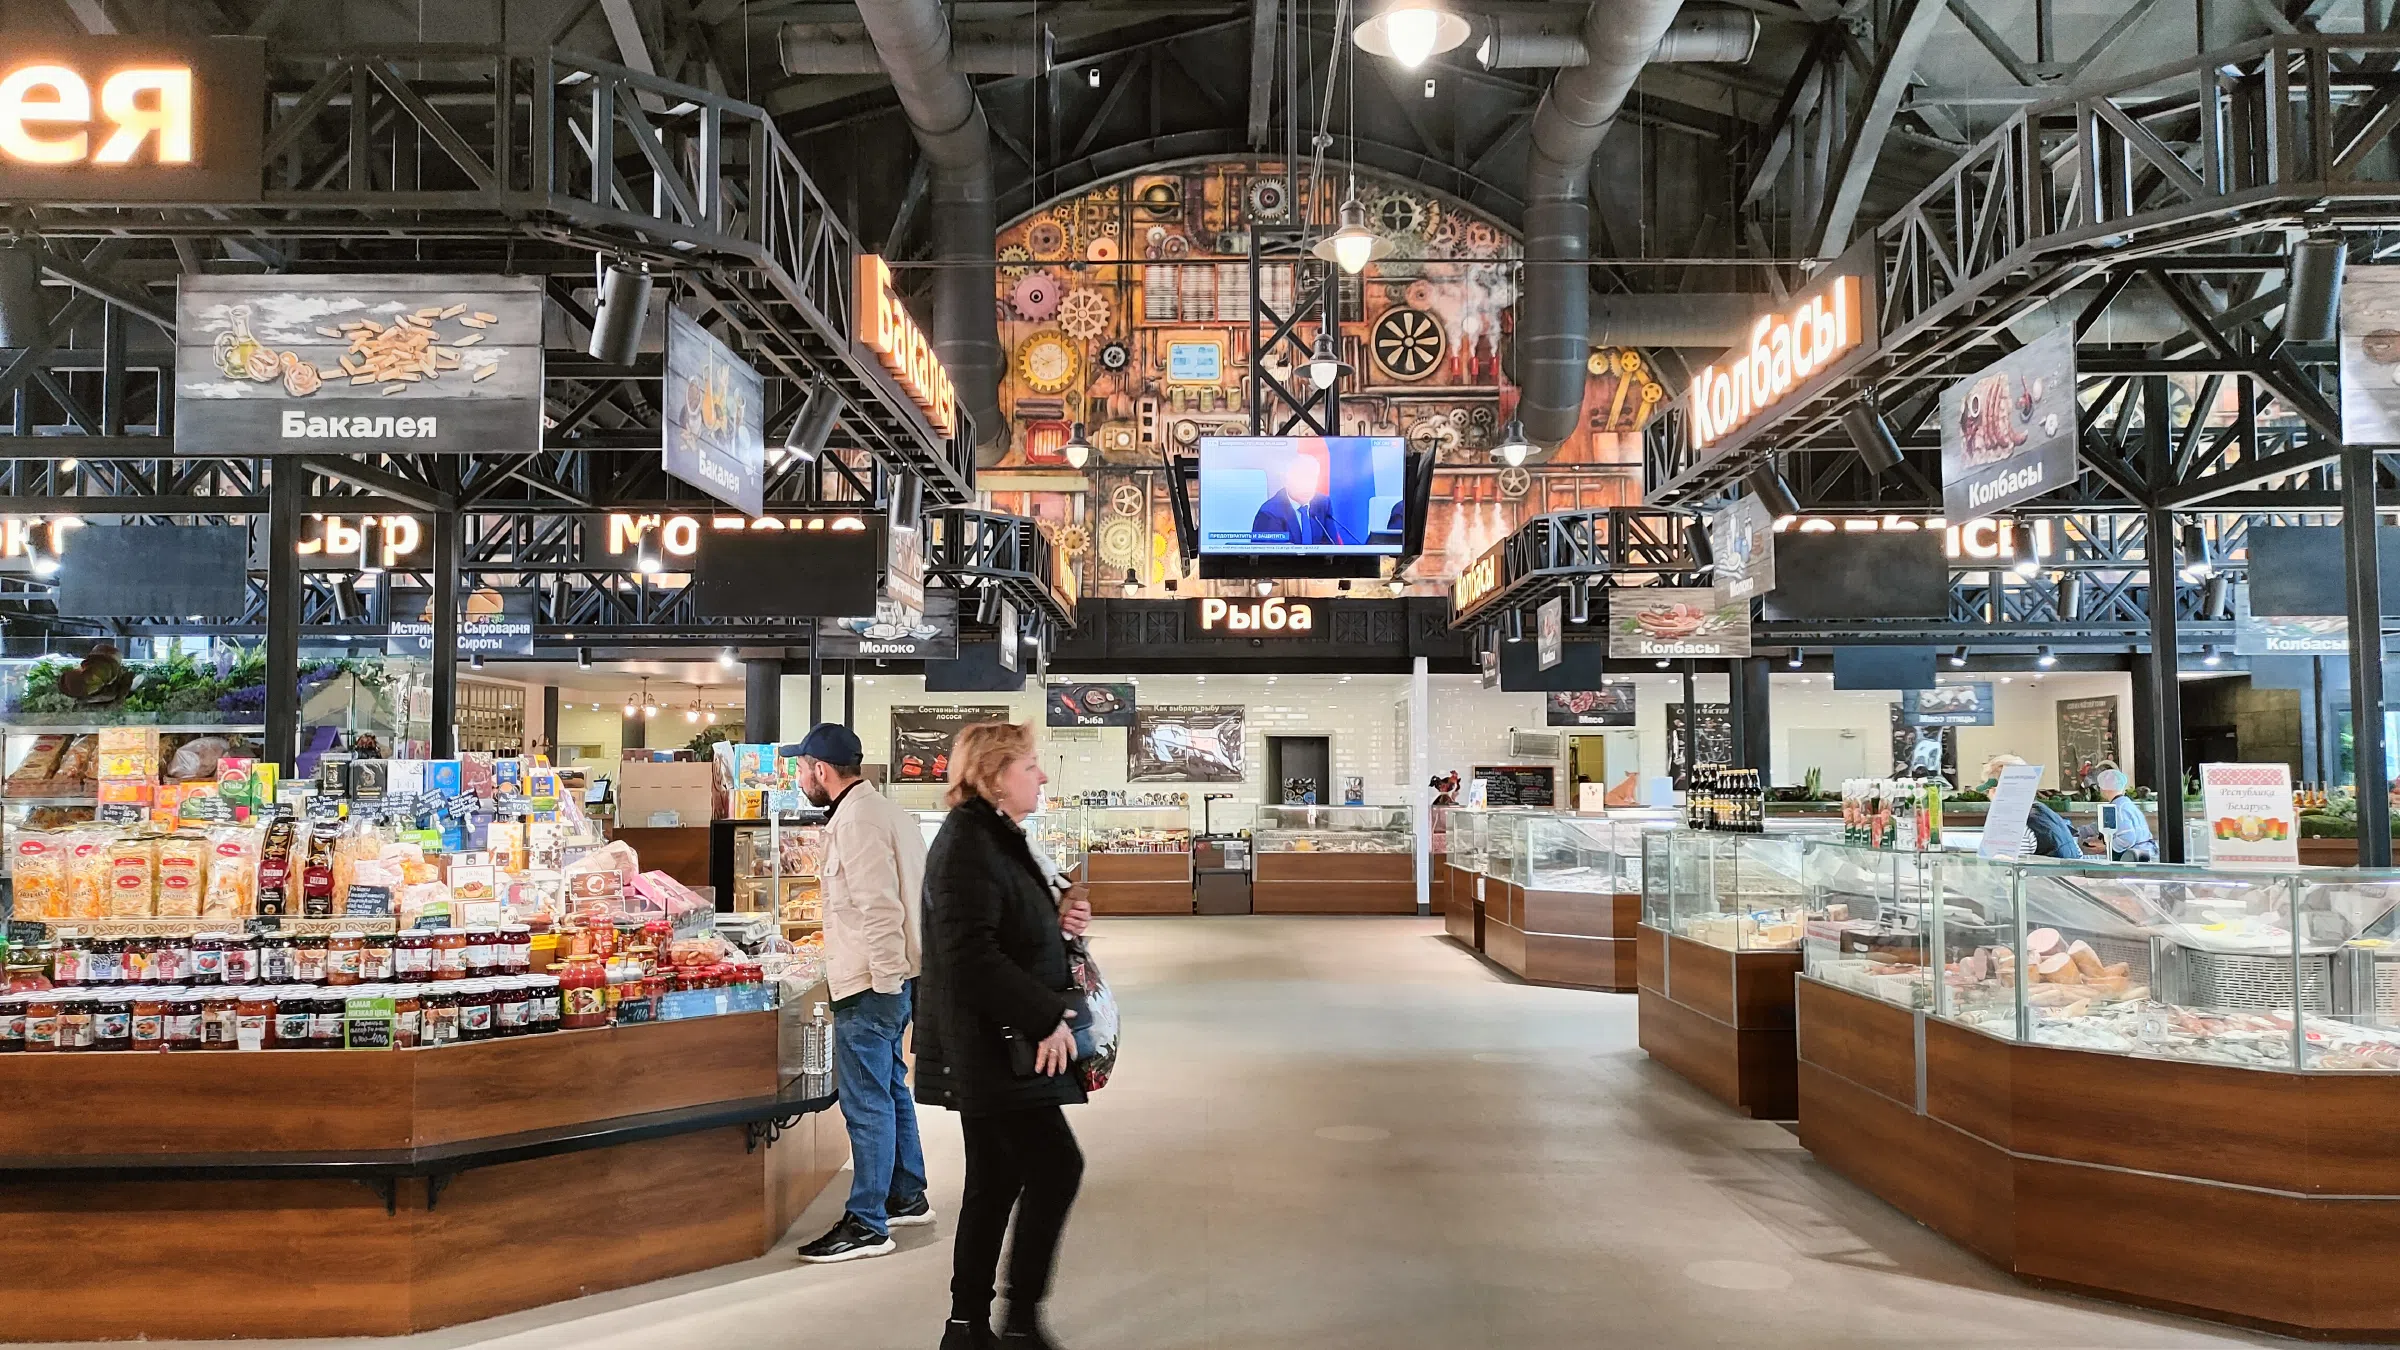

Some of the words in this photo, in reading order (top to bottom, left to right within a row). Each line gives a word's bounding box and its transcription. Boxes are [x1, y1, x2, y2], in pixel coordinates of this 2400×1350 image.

[877, 254, 955, 440] Бакалея
[1693, 275, 1848, 450] Колбасы
[282, 410, 437, 440] Бакалея
[699, 449, 740, 495] Бакалея
[1968, 459, 2043, 509] Колбасы
[297, 513, 420, 566] ыр
[1456, 554, 1495, 611] Колбасы
[1201, 598, 1312, 631] Рыба
[464, 622, 530, 637] Сыроварня
[457, 637, 502, 651] Сироты
[859, 641, 916, 655] Молоко
[1640, 640, 1721, 655] Колбасы
[2266, 637, 2348, 650] Колбасы
[1169, 705, 1199, 713] выбрать
[1201, 705, 1220, 713] рыбу
[1077, 715, 1104, 725] Рыба
[1918, 714, 1945, 723] Мясо
[1946, 715, 1976, 723] птицы
[2220, 787, 2275, 798] Республика
[2226, 802, 2272, 813] Беларусь
